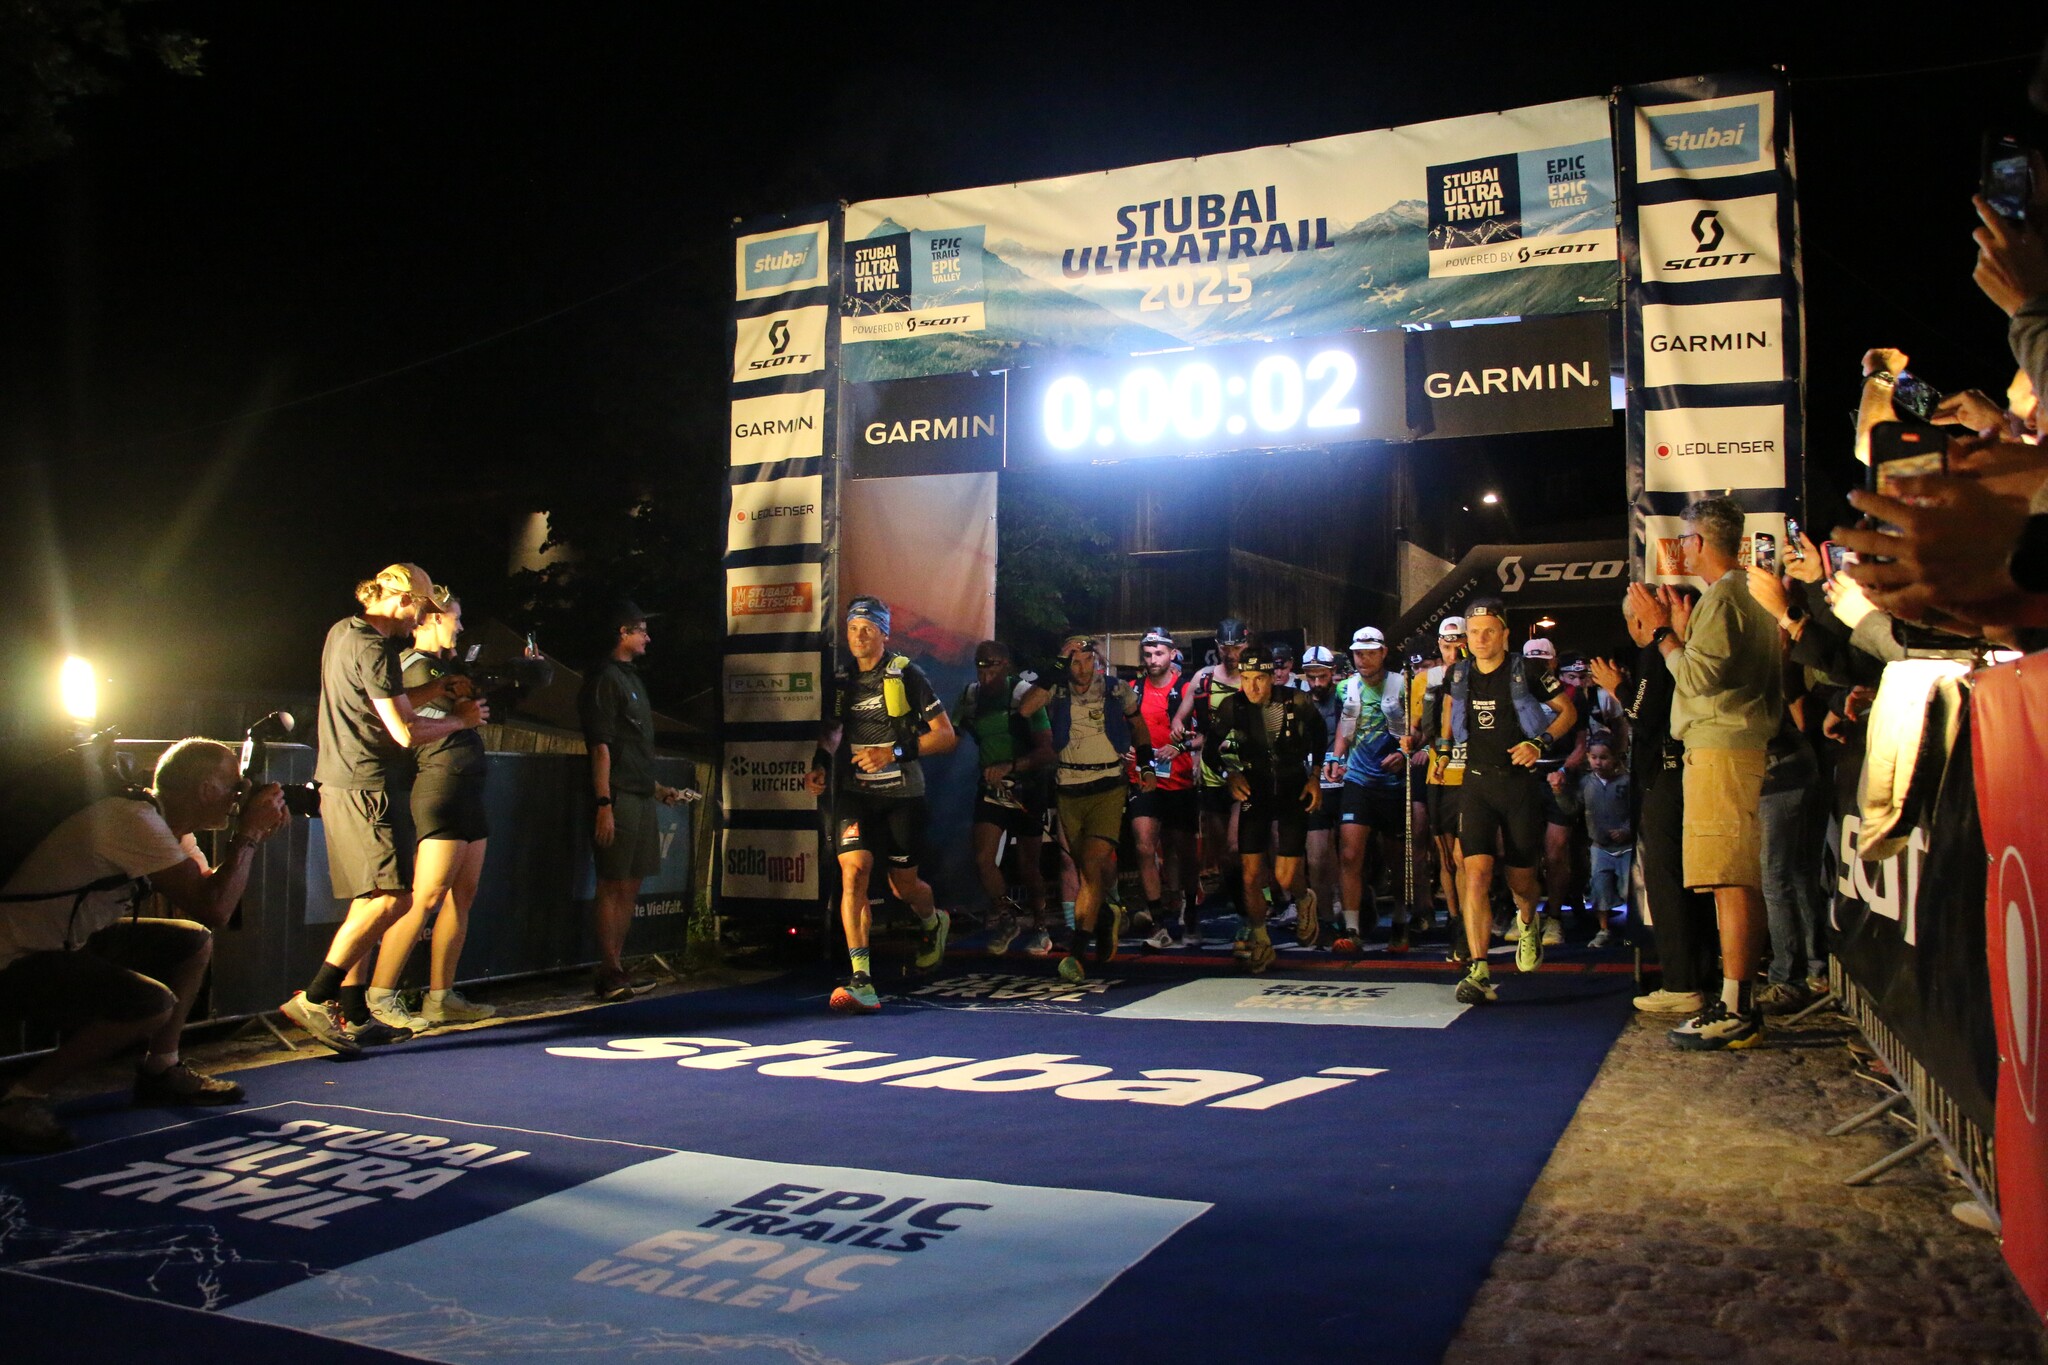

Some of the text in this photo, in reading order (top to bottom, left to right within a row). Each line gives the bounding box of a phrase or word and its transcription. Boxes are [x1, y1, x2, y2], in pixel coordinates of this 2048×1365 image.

[1664, 123, 1745, 152] stubai
[1546, 155, 1586, 175] EPIC
[1442, 167, 1499, 189] STUBAI
[1547, 170, 1586, 184] TRAILS
[1443, 182, 1504, 206] ULTRA
[1547, 179, 1588, 200] EPIC
[1549, 195, 1588, 208] VALLEY
[1116, 184, 1277, 242] STUBAI
[854, 244, 897, 262] STUBAI
[930, 237, 962, 251] EPIC
[931, 248, 960, 260] TRAILS
[1061, 217, 1335, 279] ULTRATRAIL
[753, 247, 809, 274] stubai
[931, 257, 961, 275] EPIC
[1445, 243, 1600, 268] POWERED BY SCOTT
[1662, 252, 1756, 271] SCOTT
[855, 258, 900, 277] ULTRA
[931, 271, 961, 285] VALLEY
[1139, 262, 1253, 313] 2025
[852, 314, 971, 335] POWERED BY SCOTT
[1650, 330, 1768, 353] GARMIN
[748, 353, 812, 371] SCOTT
[1423, 361, 1592, 399] GARMIN
[1043, 349, 1361, 450] 0:00:02
[735, 414, 814, 439] GARMIN
[864, 414, 996, 446] GARMIN
[1676, 439, 1775, 457] LEDLENSER
[751, 503, 815, 521] LEDLENSER
[748, 586, 795, 598] STUBAIER
[748, 596, 804, 609] GLETSCHER
[734, 678, 807, 690] PLAN B
[752, 760, 807, 776] KLOSTER
[752, 777, 806, 792] KITCHEN
[545, 1035, 1388, 1110] stubai
[249, 1119, 532, 1168] STUBAI
[164, 1136, 468, 1200] ULTRA
[747, 1181, 995, 1233] EPIC
[696, 1208, 950, 1254] TRAILS
[616, 1229, 902, 1293] EPIC
[571, 1258, 841, 1314] VALLEY
